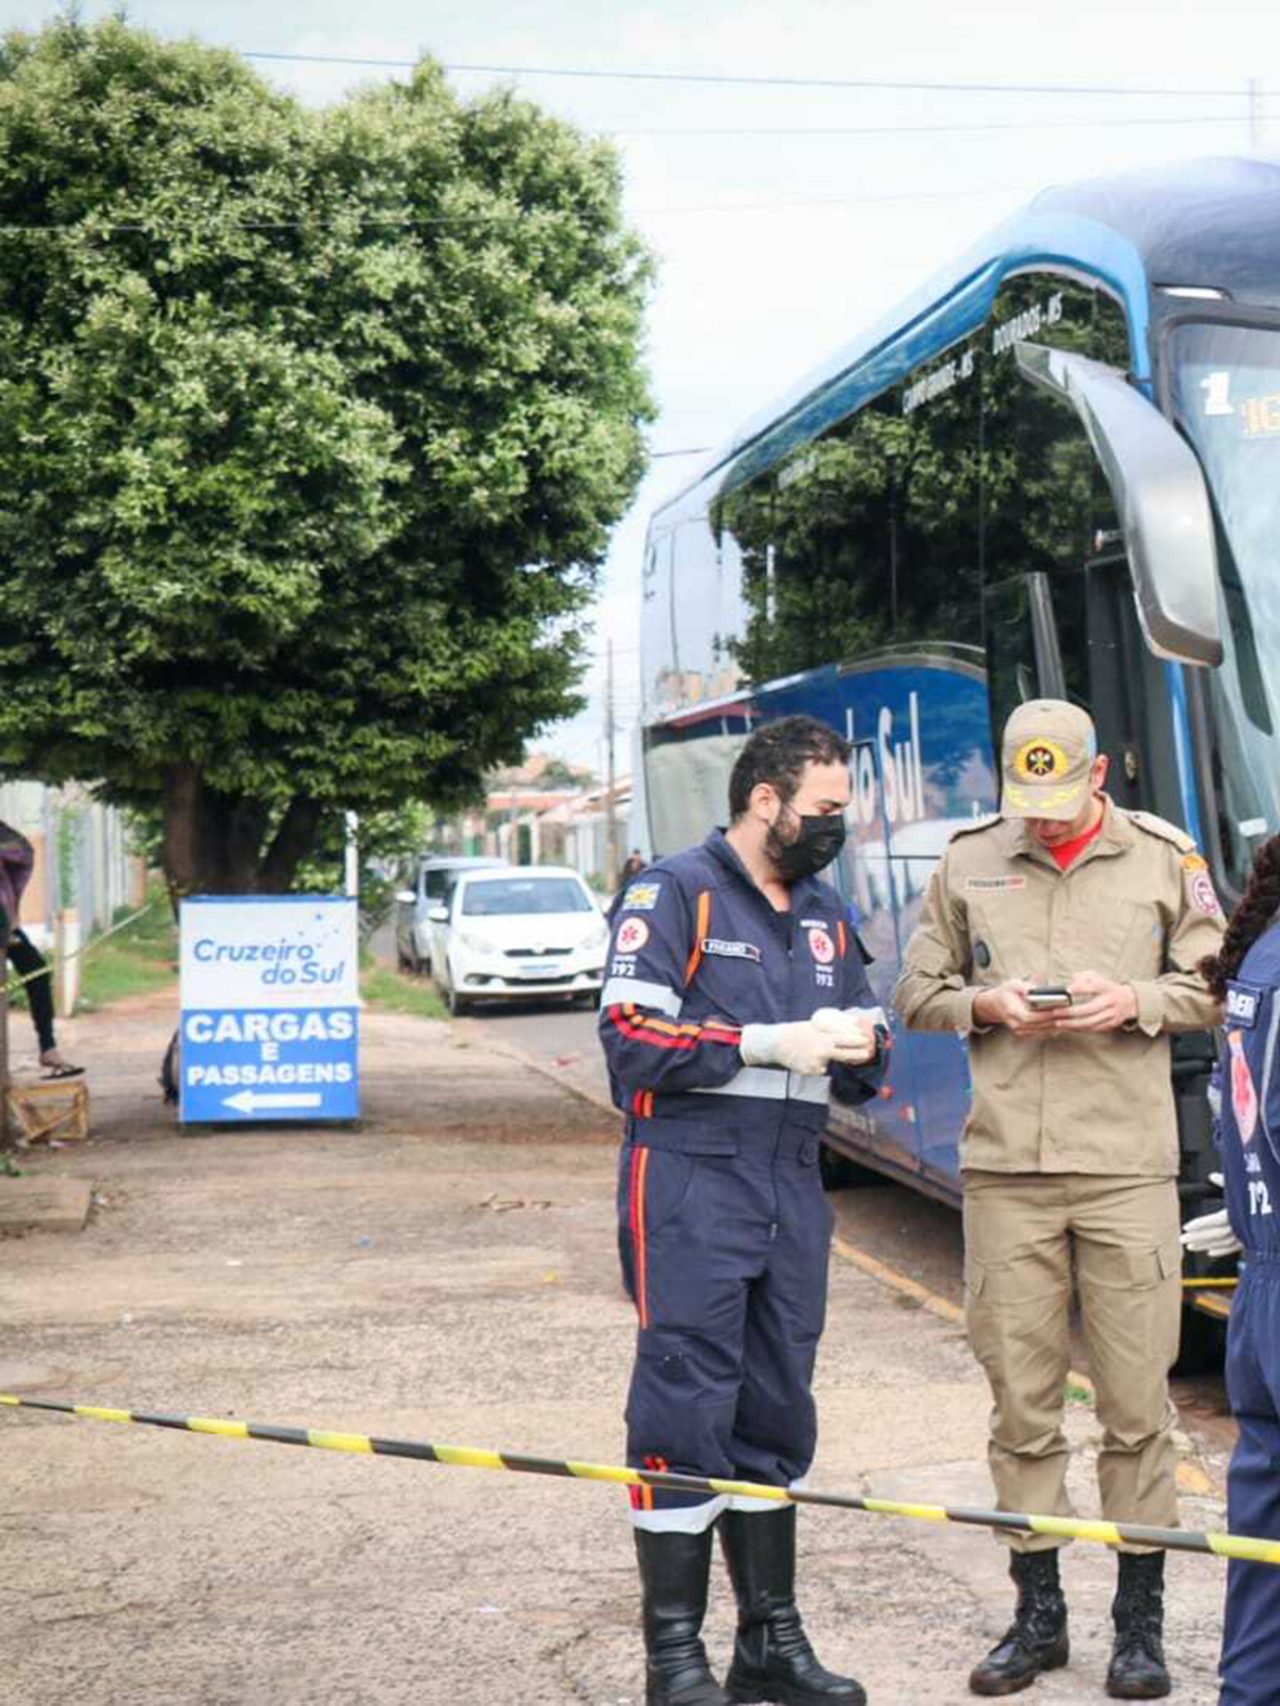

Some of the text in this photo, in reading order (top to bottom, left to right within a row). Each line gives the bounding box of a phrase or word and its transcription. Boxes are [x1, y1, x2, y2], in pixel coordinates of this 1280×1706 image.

[1199, 371, 1235, 416] 1
[879, 691, 925, 824] Sul
[192, 937, 314, 963] Cruzeiro
[261, 960, 345, 985] do Sul
[611, 963, 636, 976] 192
[185, 1010, 355, 1044] CARGAS
[260, 1043, 280, 1062] E
[187, 1062, 352, 1086] PASSAGENS
